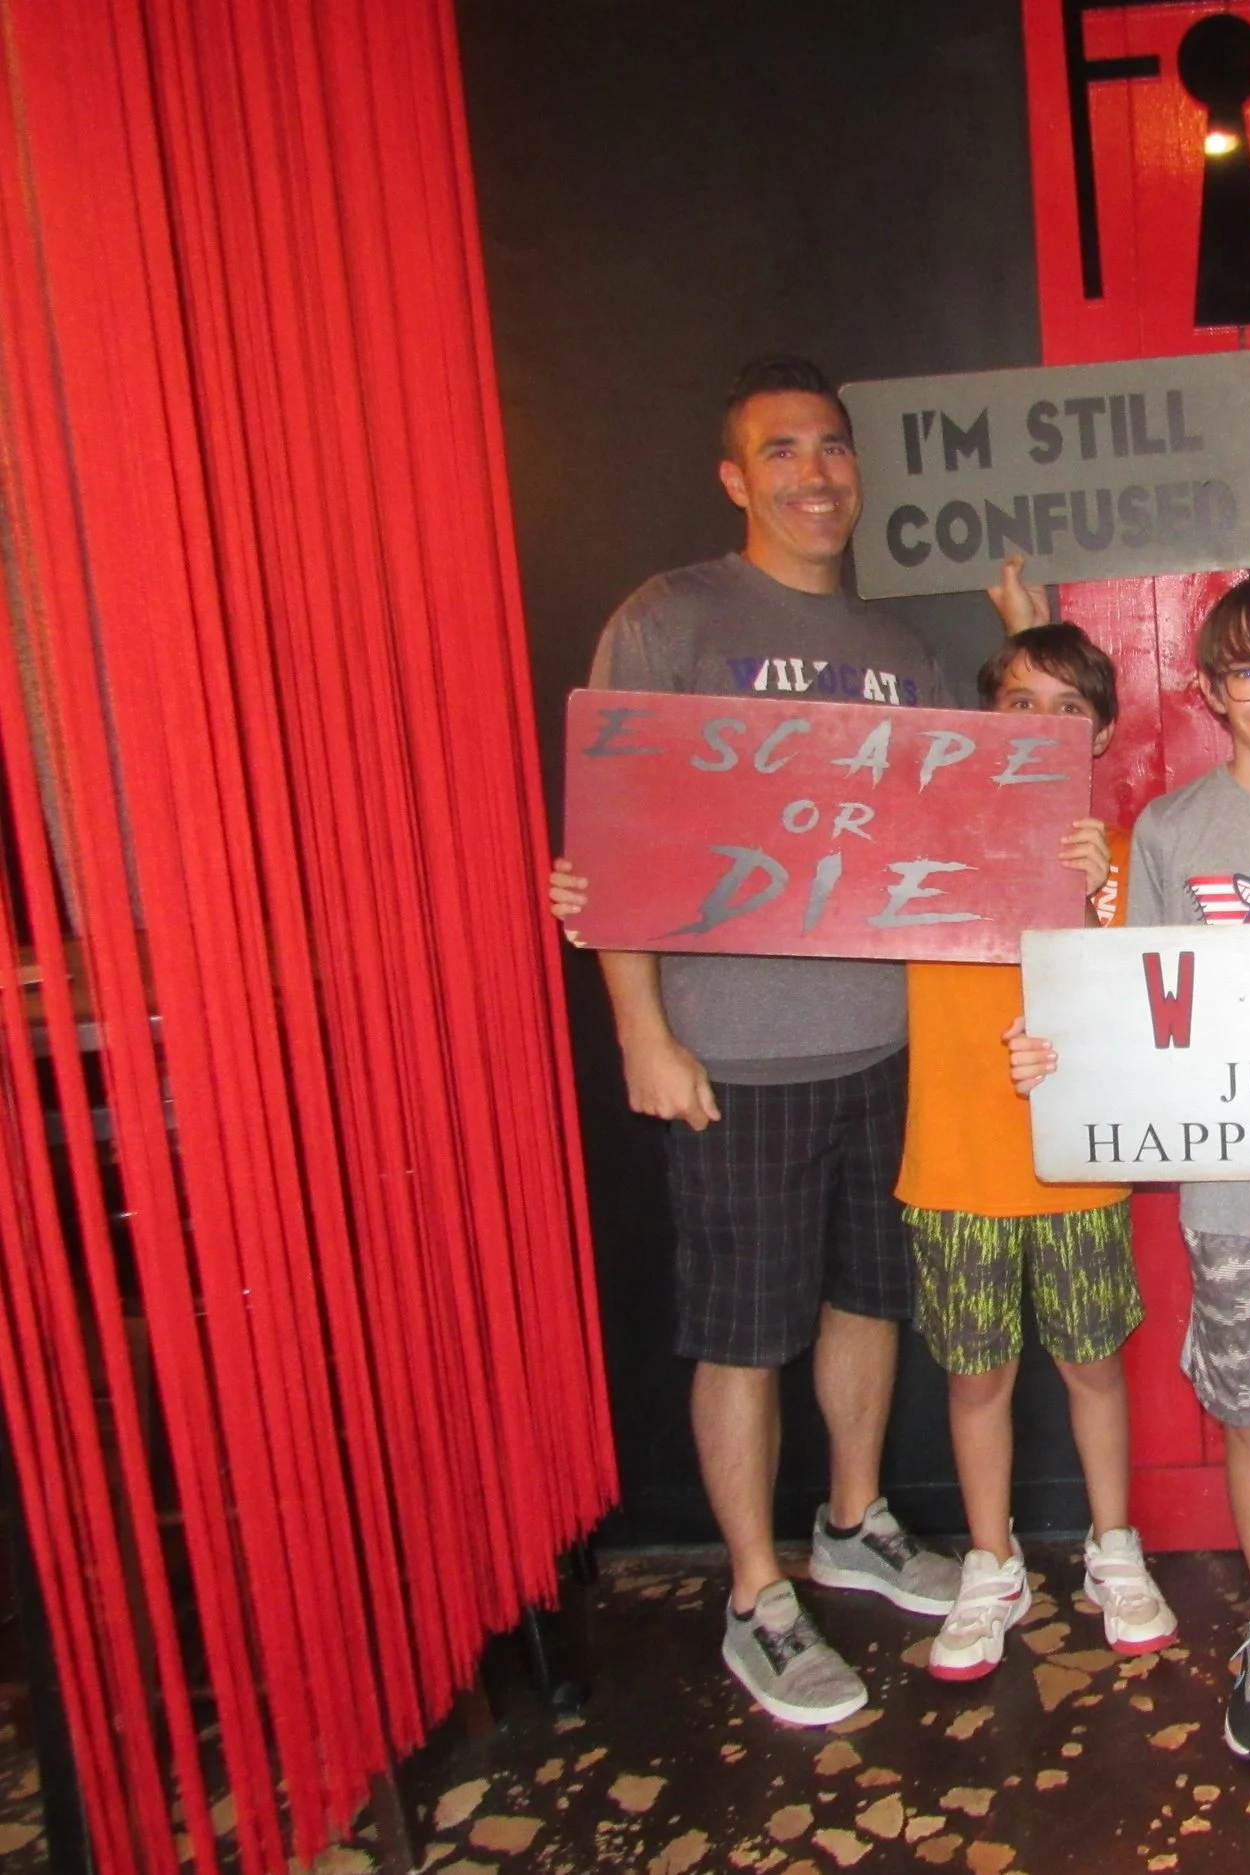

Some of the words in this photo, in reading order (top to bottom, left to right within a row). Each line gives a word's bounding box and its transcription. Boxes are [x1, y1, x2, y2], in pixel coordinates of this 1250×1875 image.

[901, 406, 993, 475] I'M
[1026, 389, 1204, 465] STILL
[886, 479, 1238, 568] CONFUSED
[726, 655, 919, 707] WILDCATS
[582, 707, 1070, 793] ESCAPE
[780, 799, 876, 842] OR
[646, 844, 995, 942] DIE
